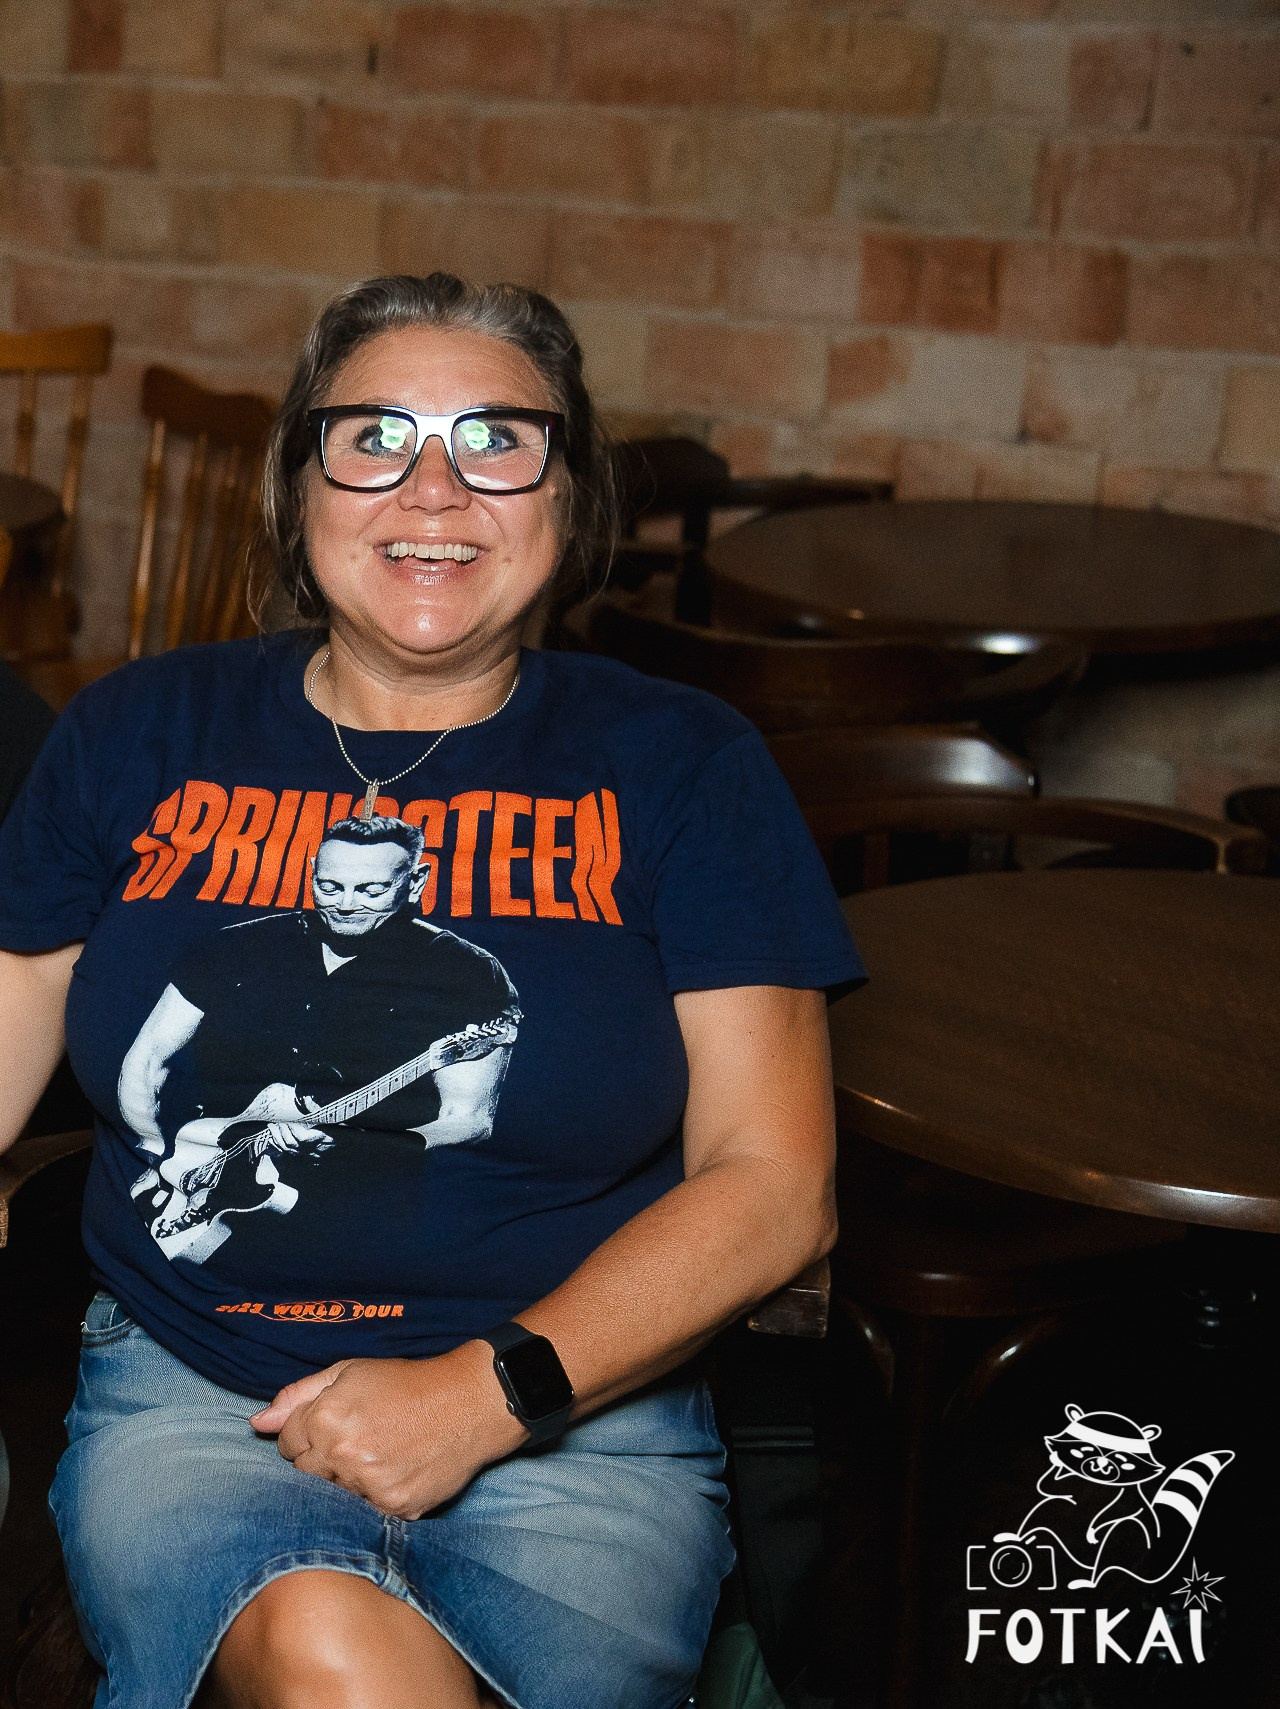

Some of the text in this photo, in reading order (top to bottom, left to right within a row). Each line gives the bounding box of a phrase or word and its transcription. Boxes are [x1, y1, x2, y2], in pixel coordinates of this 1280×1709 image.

[122, 780, 624, 925] SPRINSTEEN
[273, 1303, 342, 1317] WORLD
[352, 1304, 405, 1318] TOUR
